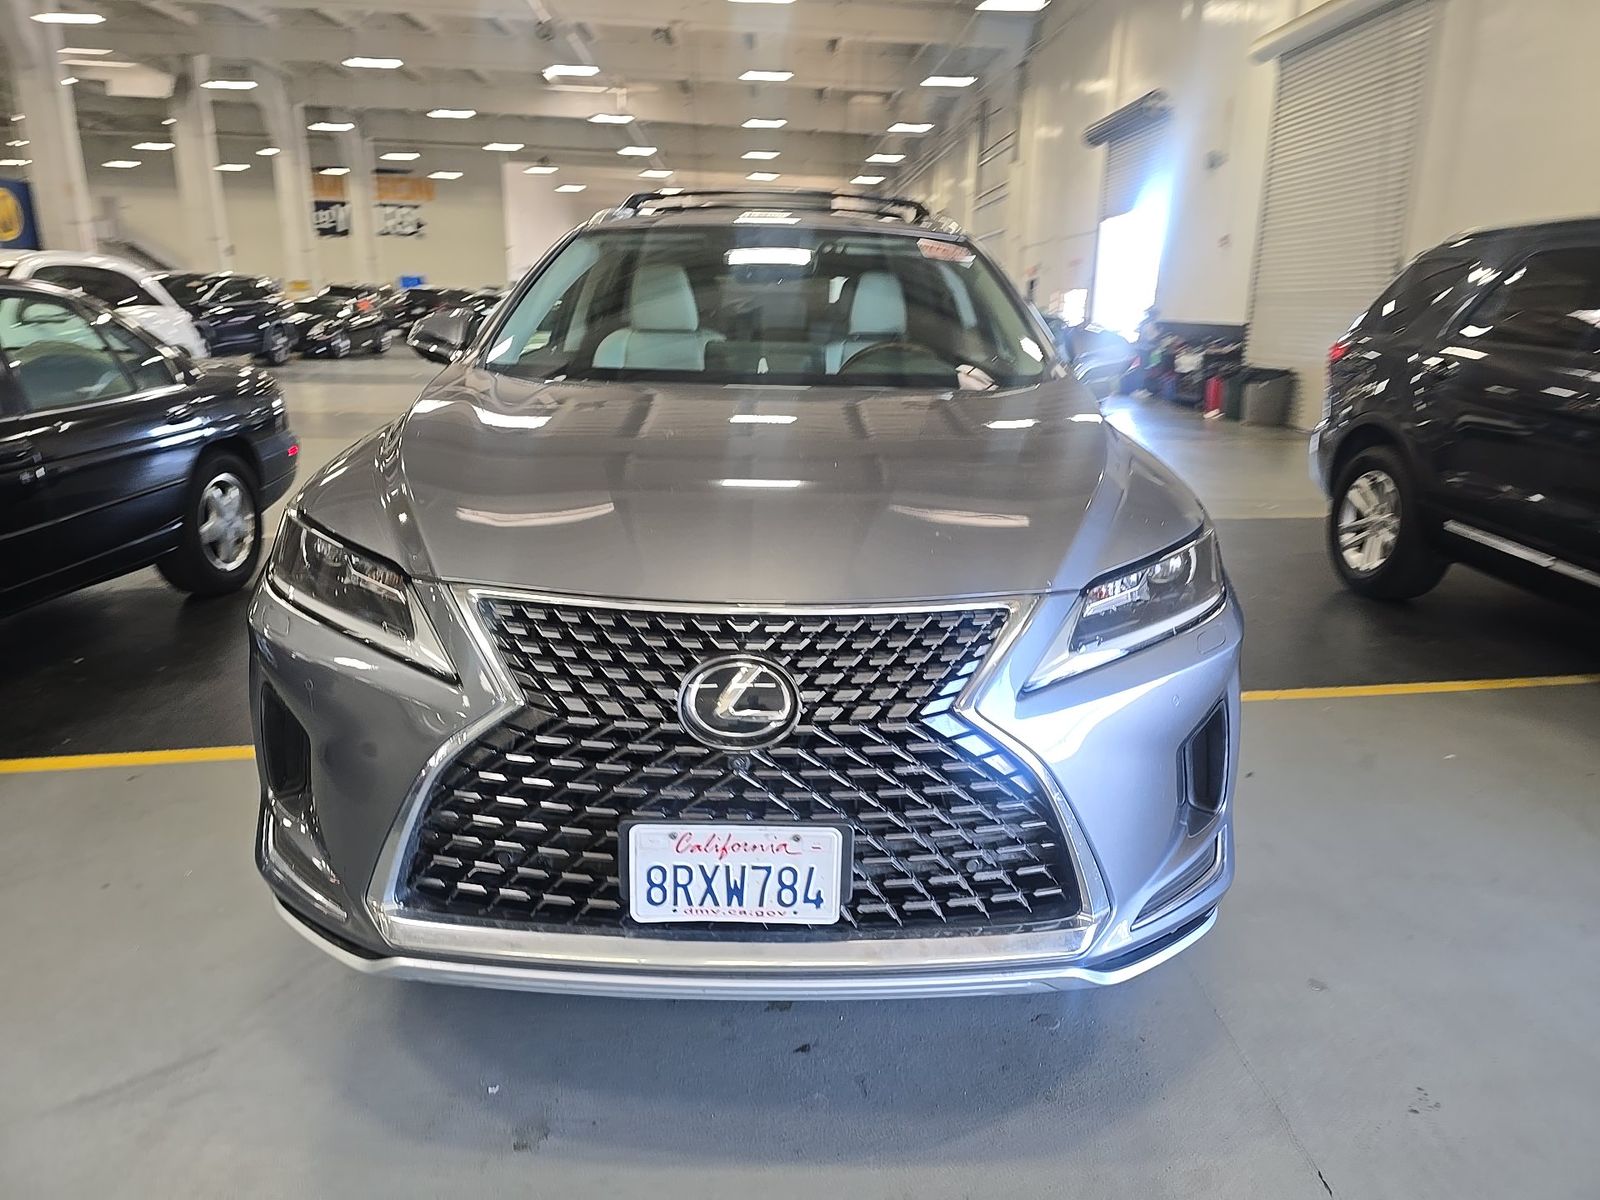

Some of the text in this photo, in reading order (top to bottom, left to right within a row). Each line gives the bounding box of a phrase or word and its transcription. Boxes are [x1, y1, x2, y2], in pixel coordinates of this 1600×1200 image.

[674, 831, 802, 861] California
[646, 864, 824, 909] 8RXW784
[683, 907, 787, 917] dmv.ca.gov
